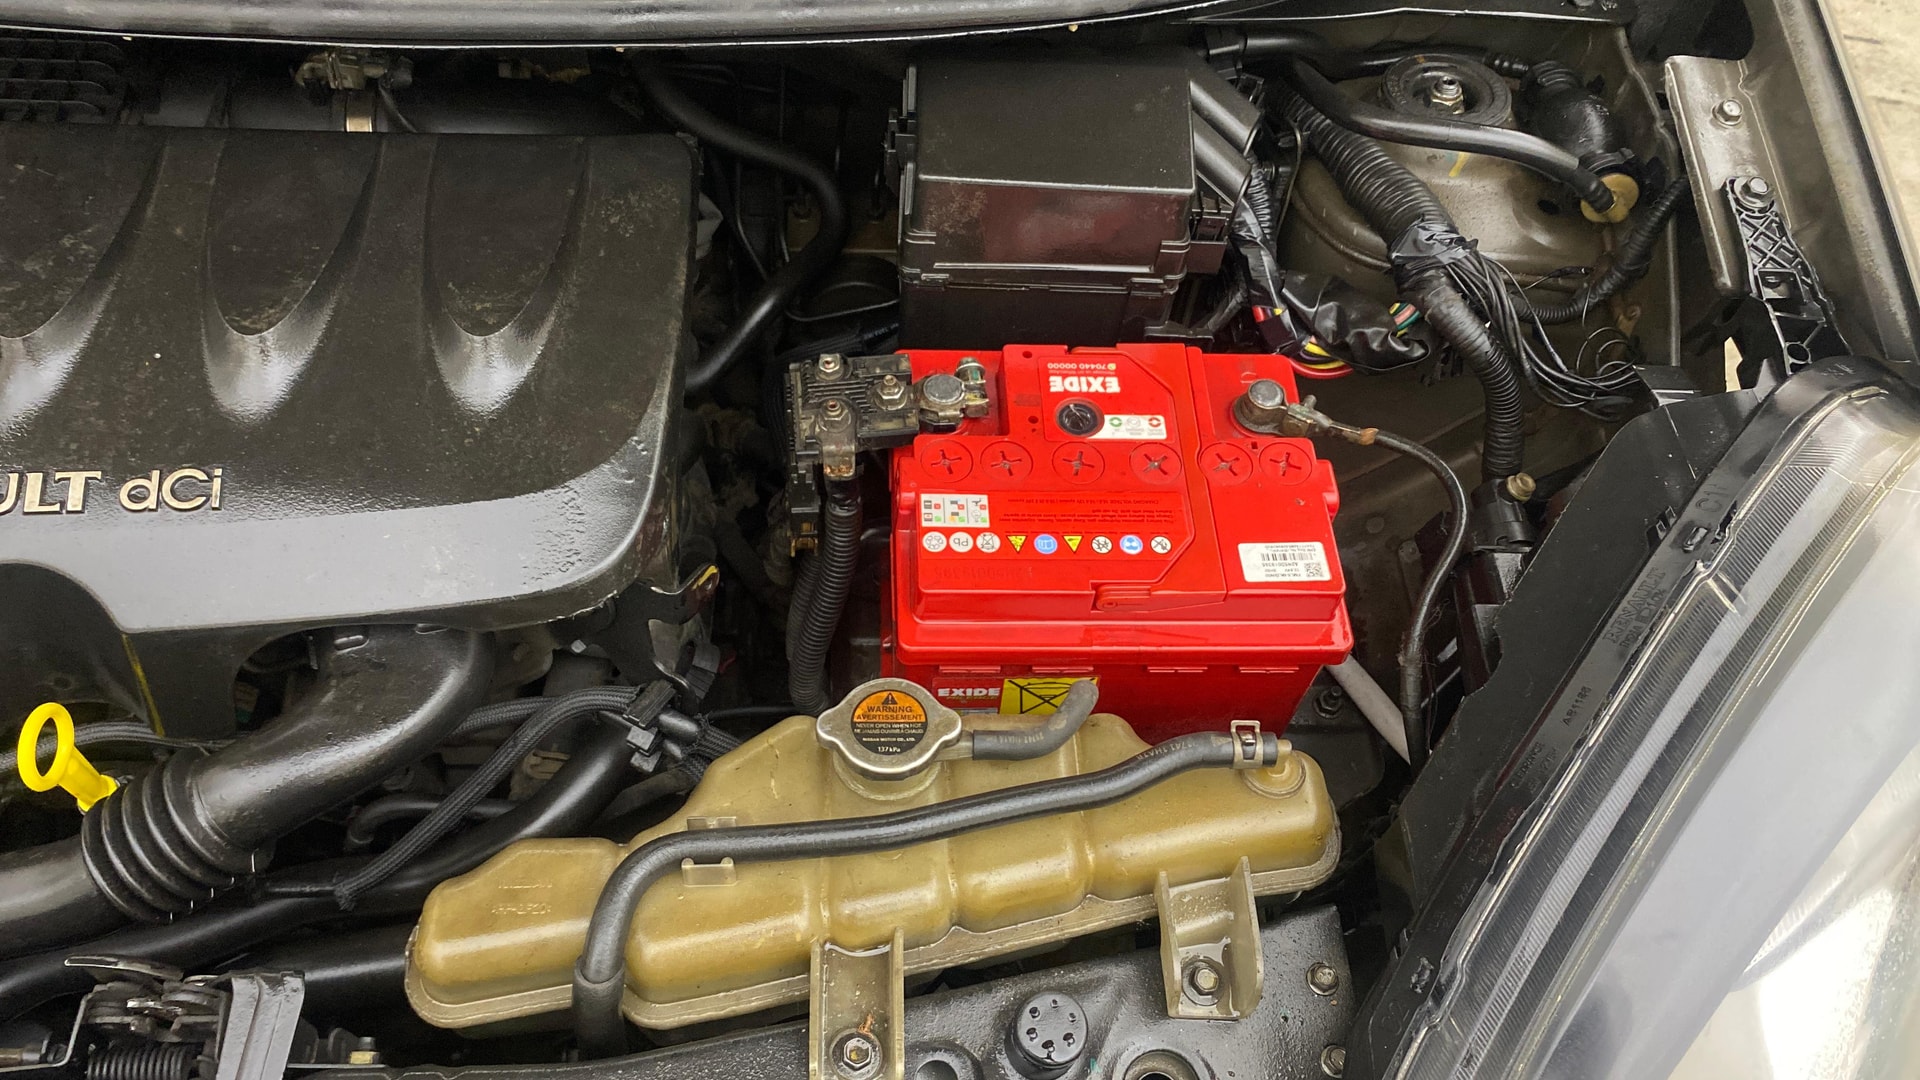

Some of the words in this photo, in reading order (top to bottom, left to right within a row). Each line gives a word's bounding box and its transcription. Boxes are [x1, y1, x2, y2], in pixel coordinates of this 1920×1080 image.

[1049, 375, 1121, 393] EXIDE
[119, 468, 223, 511] dCi
[953, 538, 969, 547] Pb
[1602, 566, 1666, 644] RENAULT
[937, 687, 1001, 697] EXIDE
[867, 705, 913, 713] WARNING
